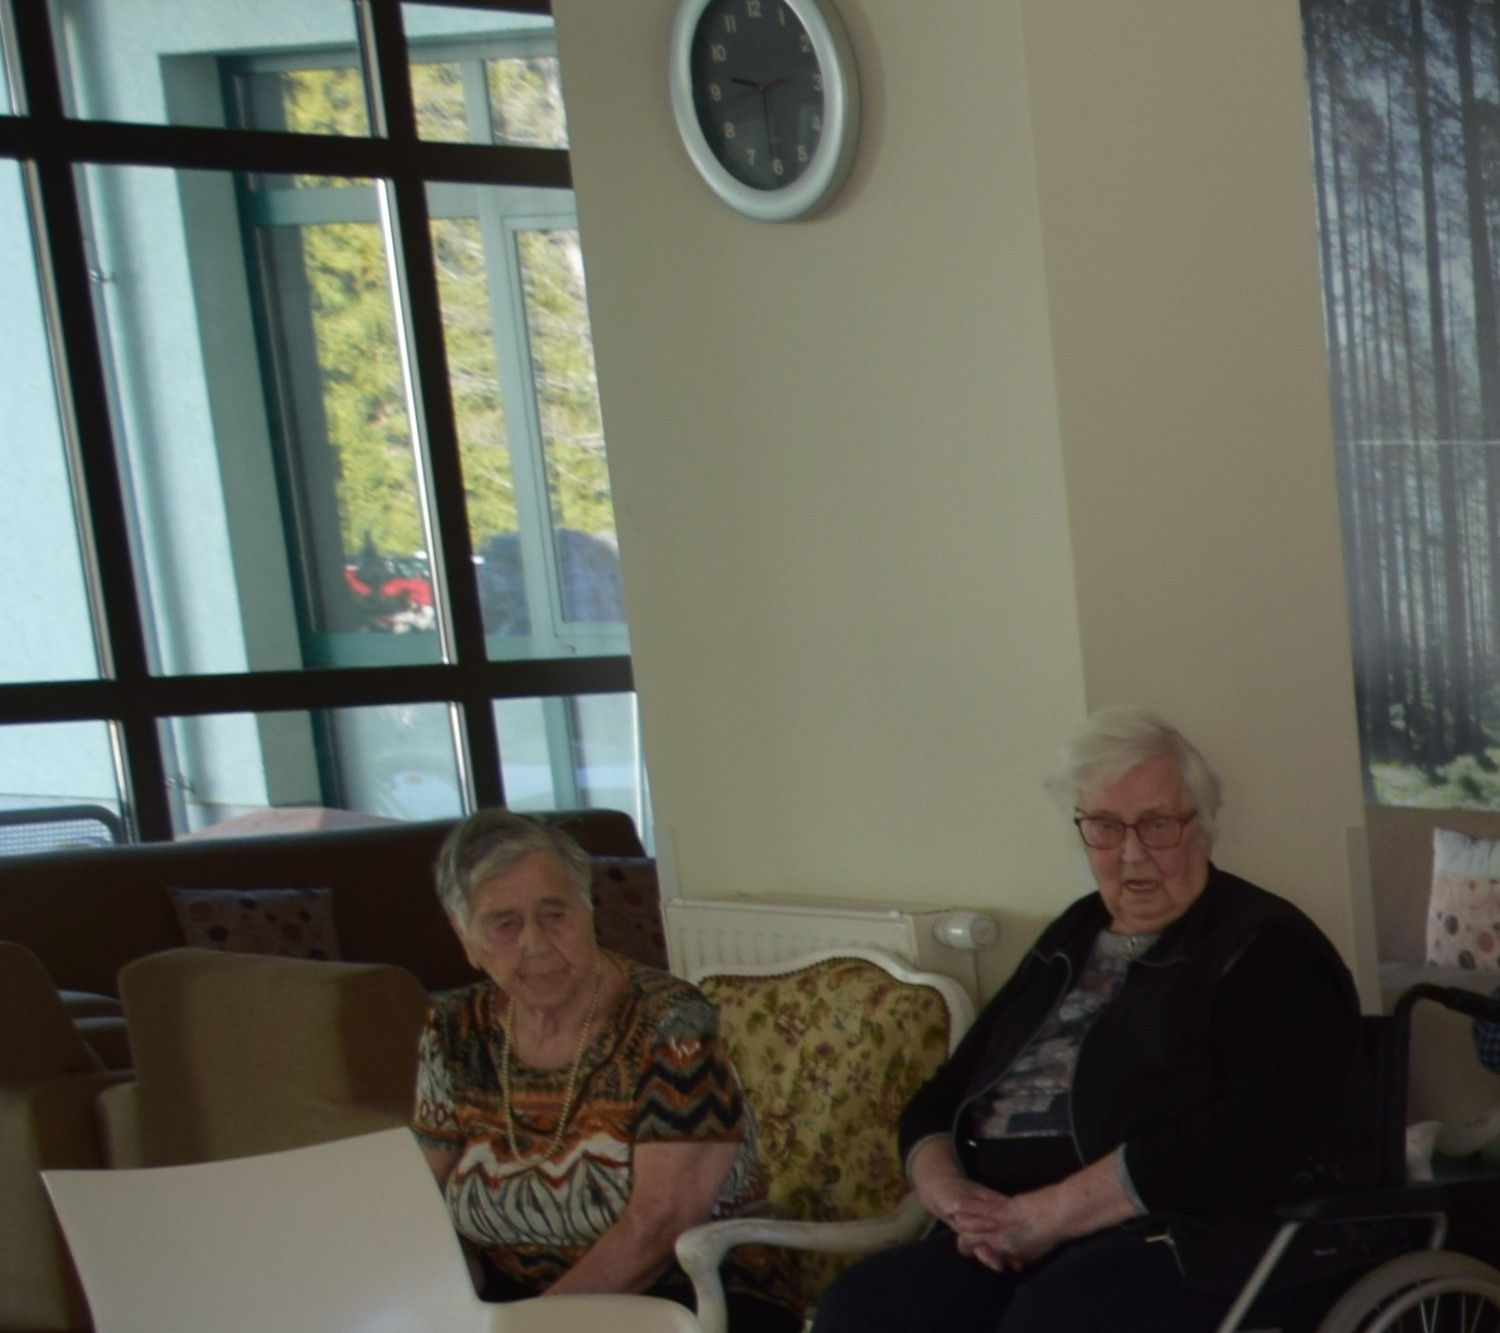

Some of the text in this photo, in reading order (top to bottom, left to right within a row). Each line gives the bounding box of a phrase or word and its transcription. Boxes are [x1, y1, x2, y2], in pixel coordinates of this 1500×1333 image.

[747, 0, 763, 18] 12
[724, 15, 737, 33] 11
[800, 33, 812, 53] 2
[711, 44, 727, 62] 10
[709, 84, 722, 102] 9
[723, 121, 736, 139] 8
[746, 149, 757, 166] 7
[796, 144, 809, 163] 5
[772, 157, 784, 176] 6
